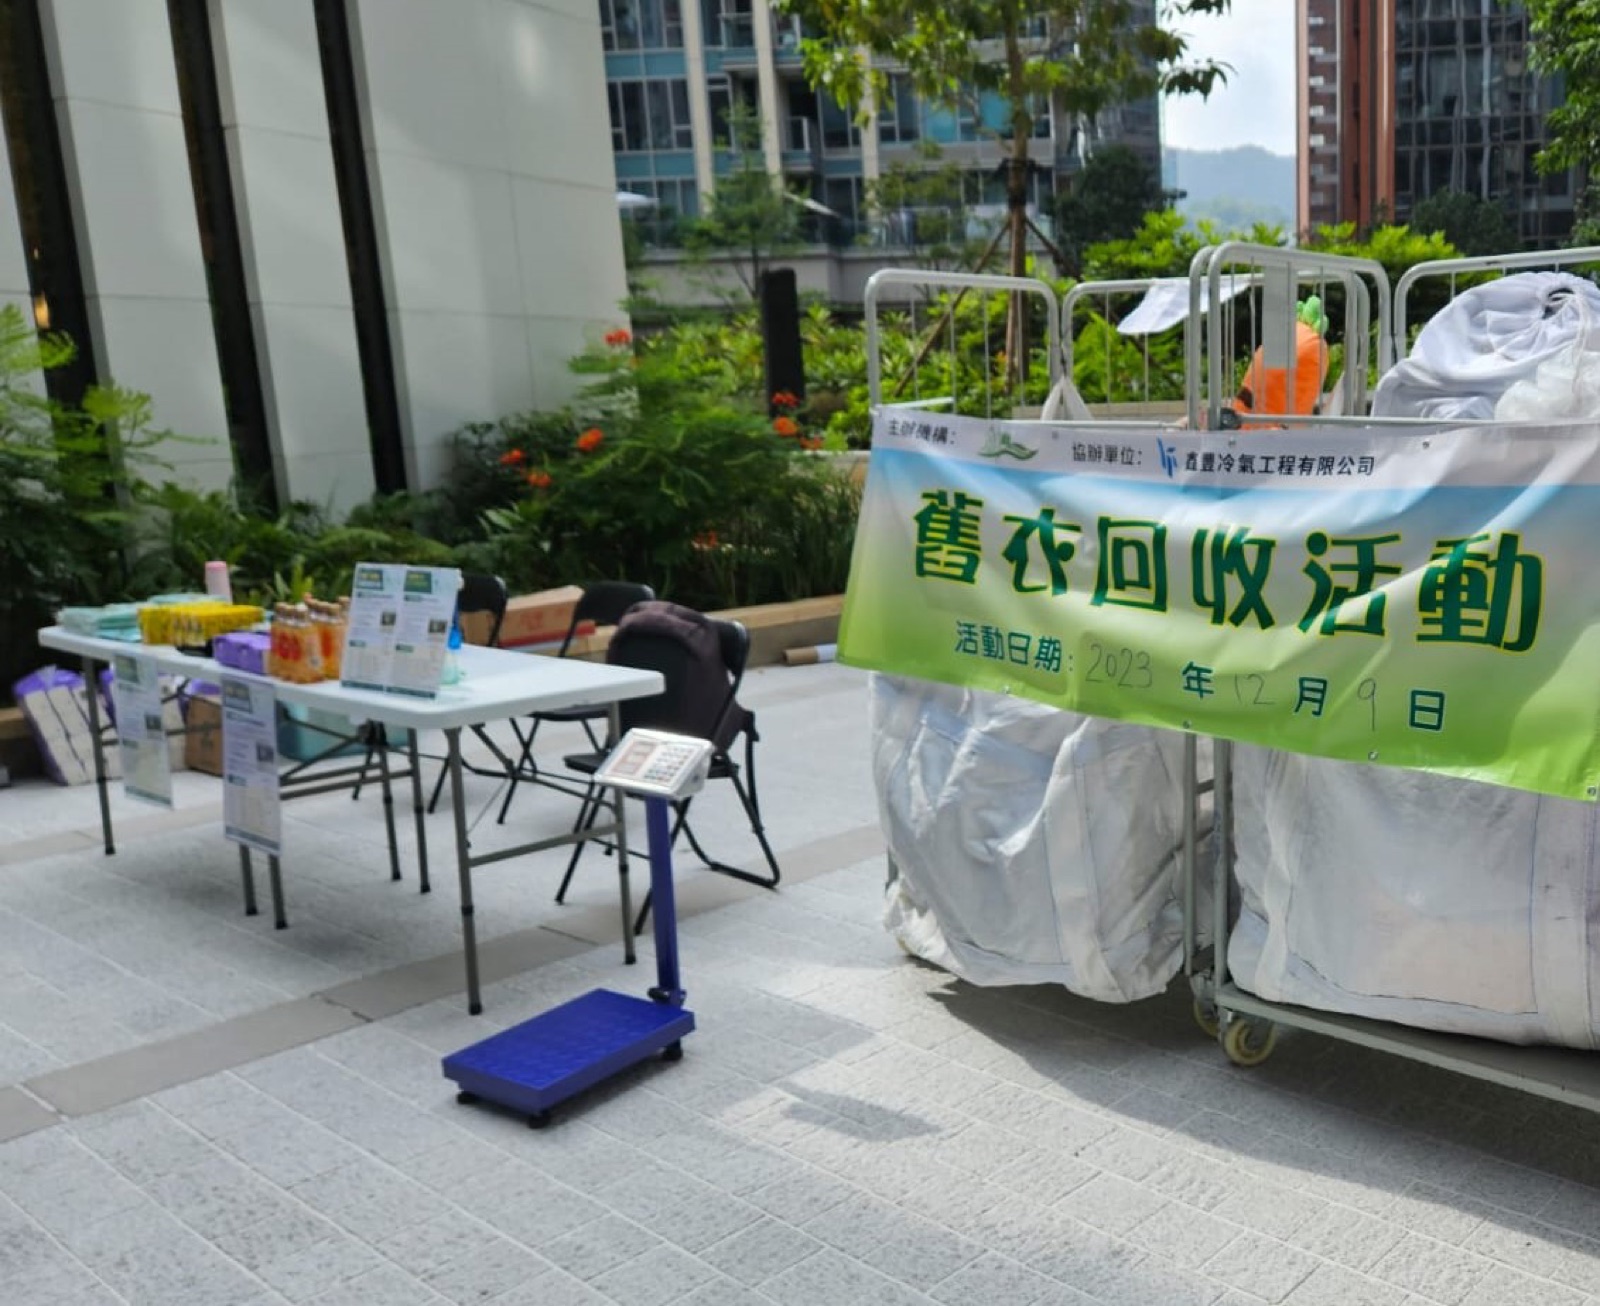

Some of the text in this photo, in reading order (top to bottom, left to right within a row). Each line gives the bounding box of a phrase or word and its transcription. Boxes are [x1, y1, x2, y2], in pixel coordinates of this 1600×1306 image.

[911, 489, 1545, 654] 舊衣回收活動
[1085, 643, 1152, 688] 2023
[1181, 661, 1215, 698] 年
[1233, 673, 1276, 705] 12
[1294, 676, 1328, 716] 月
[1357, 677, 1377, 731] 9
[1409, 690, 1445, 732] 日
